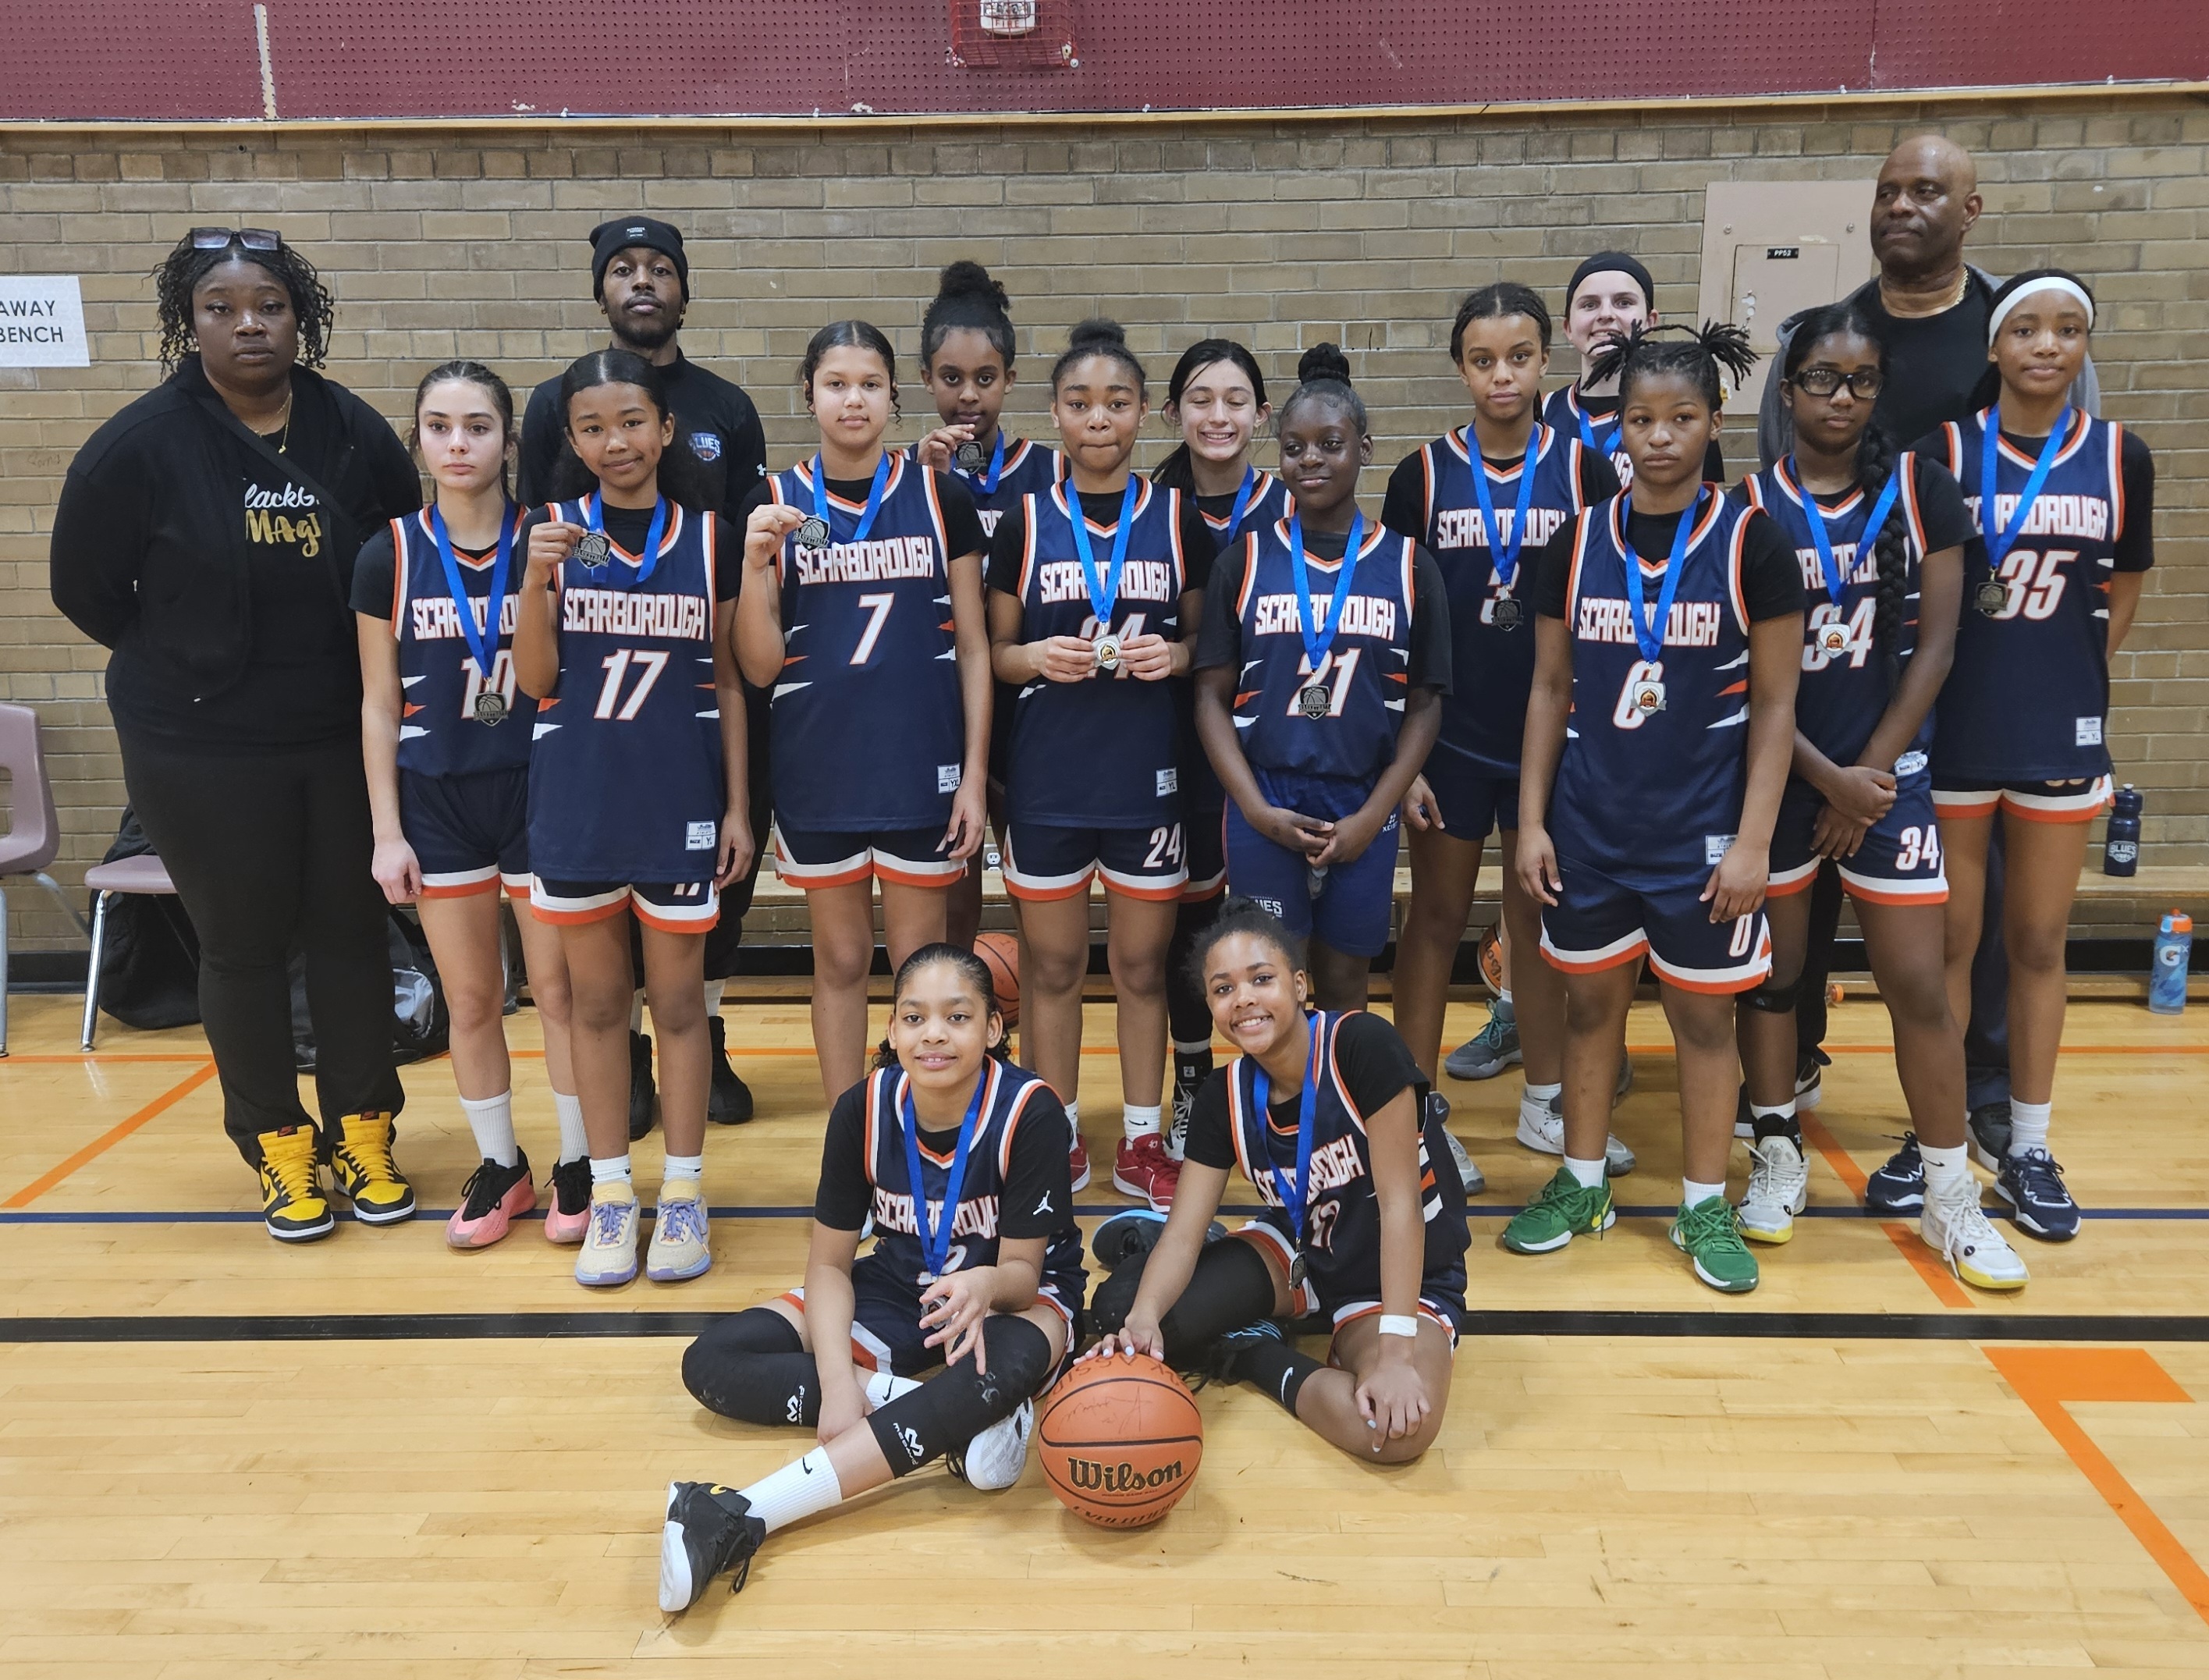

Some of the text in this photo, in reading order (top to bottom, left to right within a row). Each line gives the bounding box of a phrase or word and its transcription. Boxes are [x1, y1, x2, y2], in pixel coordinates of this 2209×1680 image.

[0, 300, 55, 317] AWAY
[794, 535, 934, 586] SCARBOROUGH
[1991, 548, 2080, 620] 35
[563, 587, 705, 641] SCARBOROUGH
[849, 592, 896, 666] 7
[1801, 595, 1877, 672] 34
[460, 648, 517, 719] 10
[593, 648, 670, 720] 17
[1287, 647, 1362, 717] 21
[1142, 822, 1181, 868] 24
[1895, 824, 1940, 871] 34
[2109, 844, 2136, 856] BLUES
[1728, 912, 1753, 957] 0
[1067, 1455, 1184, 1493] Wilson
